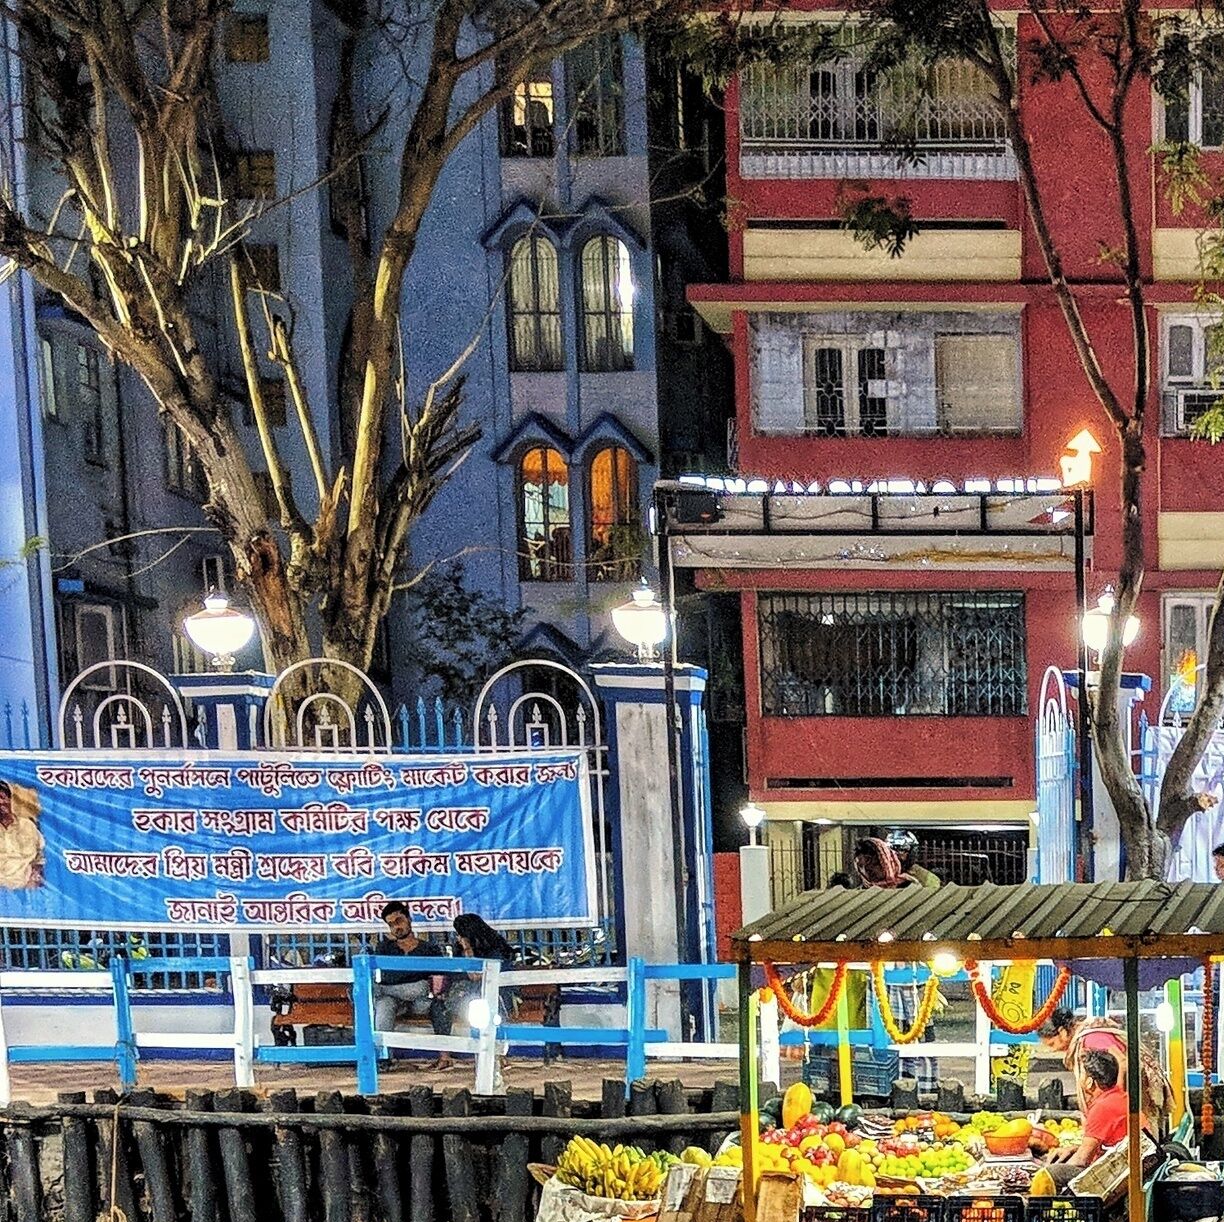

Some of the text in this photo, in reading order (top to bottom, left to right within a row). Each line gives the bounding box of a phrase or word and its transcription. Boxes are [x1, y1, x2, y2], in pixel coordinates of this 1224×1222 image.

[38, 766, 134, 790] হকারদের
[138, 762, 230, 798] পুনর্বাসনে
[236, 761, 323, 797] পাটুলিতে
[326, 762, 396, 794] ফ্লোটিং
[473, 766, 531, 787] করার
[534, 761, 577, 784] জন্য
[133, 801, 490, 837] হকার সংগ্রাম কমিটির পক্ষ থেকে
[64, 845, 563, 883] আমাদের প্রিয় মন্ত্রী শ্রদ্ধেয় ববি হাকিম মহাশয়কে
[165, 890, 463, 923] জানাই আন্তরিক অভিন্দন।
